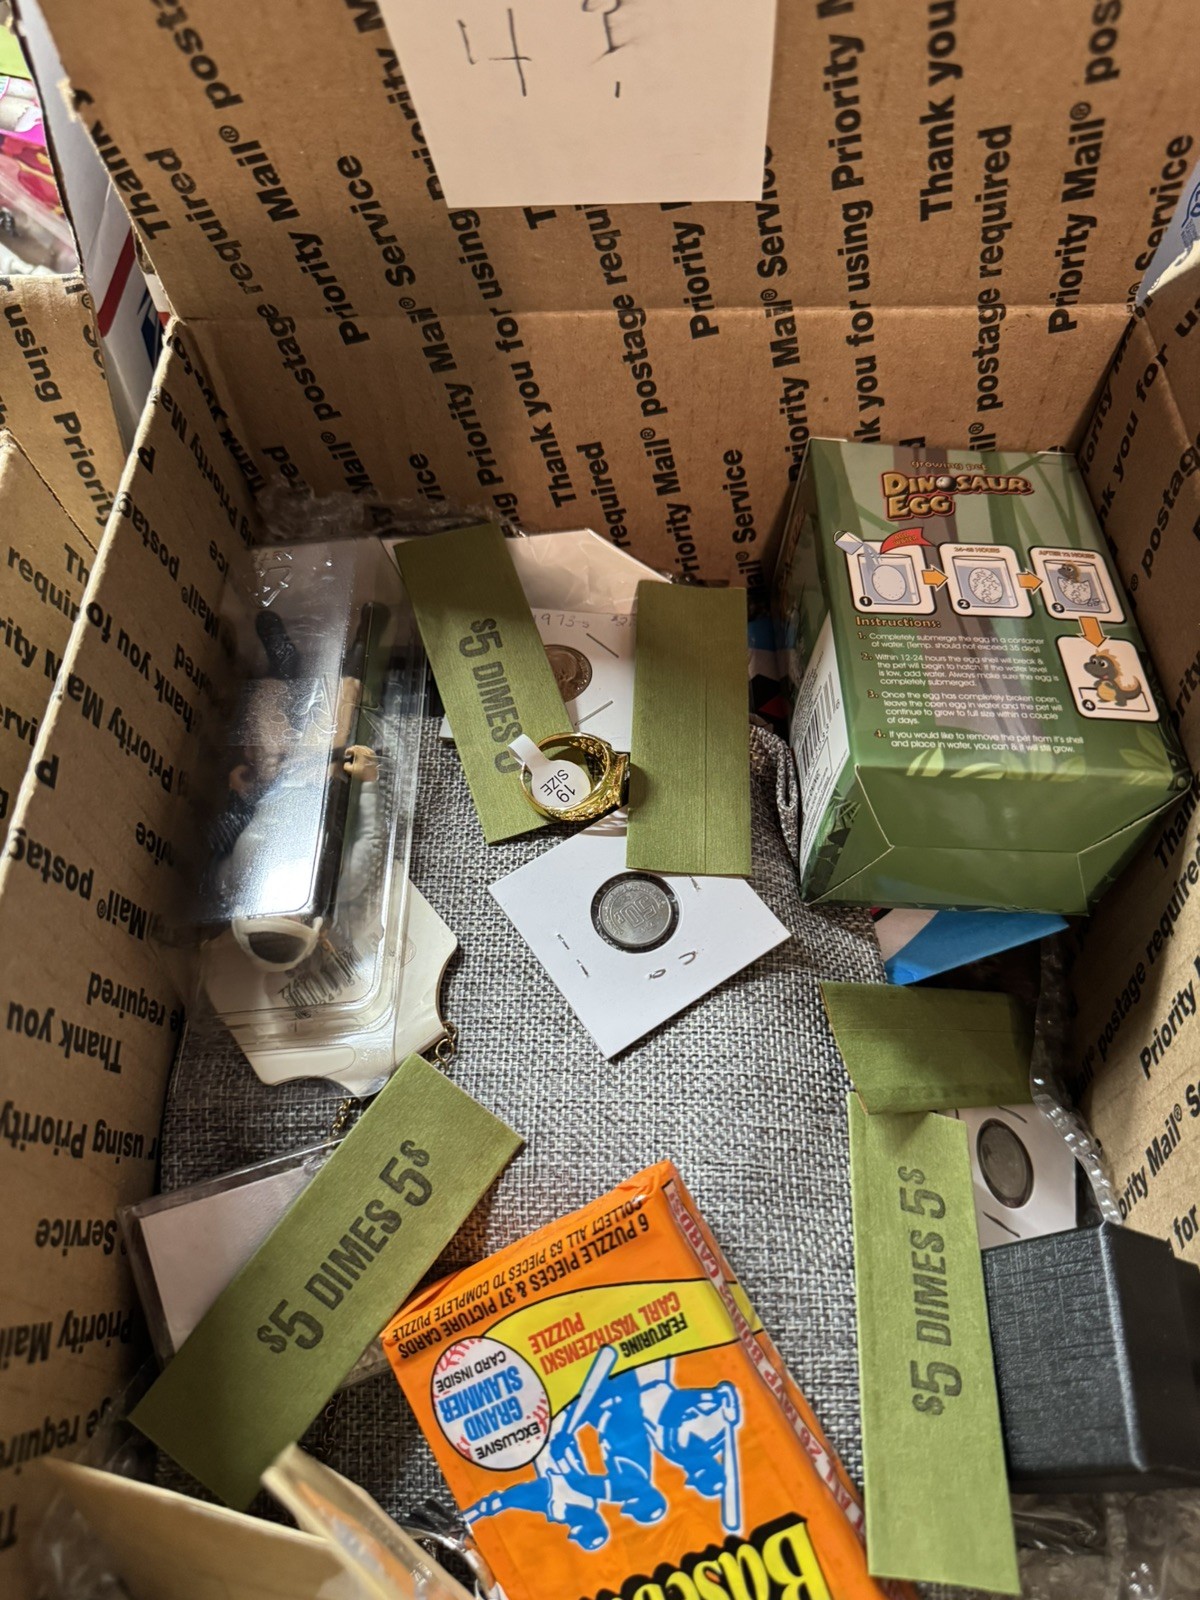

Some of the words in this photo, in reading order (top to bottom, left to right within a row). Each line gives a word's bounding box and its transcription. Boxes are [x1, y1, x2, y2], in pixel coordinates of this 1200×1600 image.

[150, 0, 243, 110] post
[927, 0, 963, 87] you
[823, 33, 866, 192] Priority
[919, 95, 955, 222] Thank
[145, 148, 264, 296] required
[336, 154, 416, 290] Service
[975, 124, 1013, 280] required
[448, 207, 503, 301] using
[575, 204, 628, 286] requi
[837, 200, 873, 293] using
[288, 231, 371, 347] Priority
[671, 221, 721, 340] Priority
[1048, 213, 1098, 335] Priority
[488, 308, 524, 355] for
[845, 299, 875, 347] for
[972, 288, 1007, 413] postage
[4, 303, 63, 402] using
[257, 302, 342, 423] postage
[612, 293, 670, 417] postage
[511, 361, 553, 417] you
[855, 356, 886, 410] you
[444, 382, 504, 488] Priority
[1113, 410, 1139, 482] you
[1136, 343, 1169, 403] for
[530, 421, 577, 508] Thank
[576, 441, 631, 547] required
[722, 448, 757, 544] Service
[888, 496, 952, 518] EGG
[459, 617, 503, 658] $5
[855, 616, 941, 628] Instructions:
[117, 627, 154, 681] you
[472, 661, 523, 744] DIMES
[107, 707, 174, 793] Priority
[540, 769, 569, 796] SIZE
[556, 784, 576, 803] 19
[6, 1001, 56, 1044] you
[86, 971, 166, 1027] required
[1097, 961, 1147, 1063] postage
[59, 1018, 123, 1075] Thank
[1139, 978, 1197, 1080] Priority
[0, 1100, 88, 1160] Priority
[91, 1118, 144, 1164] using
[35, 1218, 118, 1256] Service
[568, 1225, 589, 1248] ALL
[584, 1222, 637, 1266] PUZZLE
[592, 1199, 643, 1234] COLLECT
[640, 1213, 649, 1232] 6
[1173, 1203, 1199, 1252] for
[256, 1298, 324, 1354] $5
[304, 1199, 402, 1311] DIMES
[492, 1270, 508, 1288] TO
[508, 1246, 548, 1280] PIECES
[516, 1284, 528, 1298] &
[530, 1251, 580, 1292] PIECES
[910, 1229, 952, 1347] DIMES
[434, 1279, 490, 1321] COMPLETE
[444, 1302, 498, 1338] PICTURE
[501, 1287, 517, 1308] 37
[638, 1291, 681, 1326] CARL
[57, 1309, 135, 1354] Priority
[391, 1314, 433, 1342] PUZZLE
[397, 1327, 443, 1360] CARDS
[528, 1311, 586, 1355] PUZZLE
[539, 1313, 641, 1376] YASTRZEMSKI
[618, 1312, 688, 1359] FEATURING
[436, 1366, 474, 1394] INSIDE
[474, 1351, 507, 1374] CARD
[910, 1360, 962, 1416] $5
[438, 1365, 523, 1423] SLAMMER
[463, 1396, 523, 1442] GRAND
[475, 1421, 541, 1460] EXCLUSIVE
